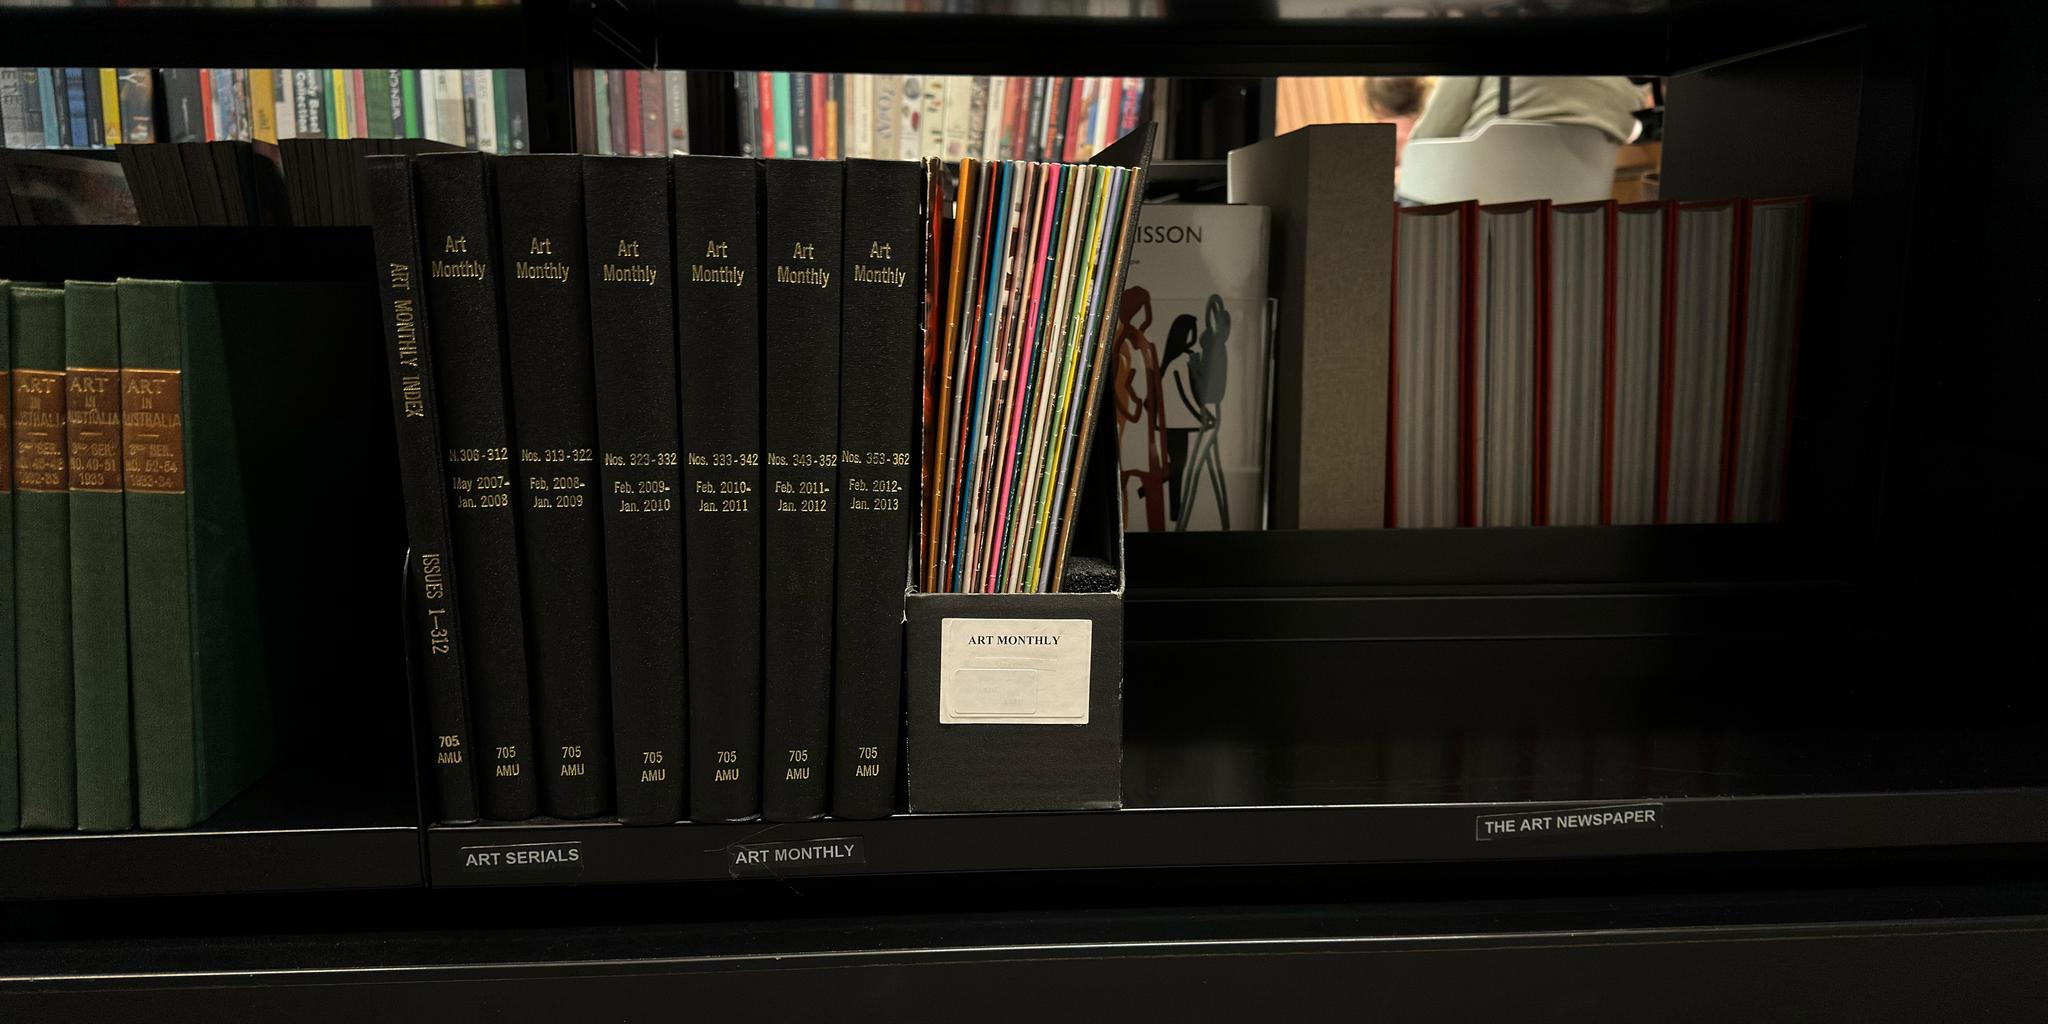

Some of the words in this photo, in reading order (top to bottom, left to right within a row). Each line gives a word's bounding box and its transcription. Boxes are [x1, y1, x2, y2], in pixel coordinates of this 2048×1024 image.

[296, 71, 308, 134] Collection
[445, 236, 467, 253] Art
[530, 238, 551, 255] Art
[618, 240, 639, 257] Art
[706, 241, 728, 258] Art
[793, 242, 814, 259] Art
[869, 241, 891, 259] Art
[390, 263, 410, 290] ART
[431, 261, 486, 280] Monthly
[516, 262, 570, 283] Monthly
[603, 264, 657, 285] Monthly
[692, 265, 744, 286] Monthly
[777, 265, 830, 288] Monthly
[855, 265, 906, 287] Monthly
[394, 300, 418, 367] MONTHLY
[18, 378, 57, 394] ART
[70, 377, 109, 394] ART
[127, 377, 166, 394] ART
[142, 395, 153, 410] IN
[402, 377, 424, 418] INDEX
[521, 449, 541, 462] Nos.
[605, 452, 626, 466] Nos.
[688, 453, 708, 466] Nos.
[767, 453, 788, 466] Nos.
[842, 451, 862, 464] Nos.
[453, 477, 473, 492] May
[614, 481, 634, 494] Feb.
[696, 481, 715, 494] Feb.
[775, 481, 794, 494] Feb.
[849, 478, 868, 491] Feb.
[458, 496, 476, 508] Jan.
[480, 494, 508, 508] 2008
[533, 496, 552, 508] Jan.
[556, 495, 583, 507] 2009
[619, 500, 639, 512] Jan.
[643, 499, 670, 511] 2010
[698, 500, 717, 512] Jan.
[722, 500, 748, 512] 2011
[777, 500, 797, 512] Jan.
[800, 500, 827, 512] 2012
[849, 497, 869, 510] Jan.
[873, 498, 899, 510] 2013
[422, 553, 443, 600] ISSUES
[968, 635, 993, 645] ART
[997, 635, 1060, 645] MONTHLY
[439, 735, 459, 748] 705
[437, 751, 462, 764] AMU
[496, 746, 515, 759] 705
[561, 746, 581, 758] 705
[643, 751, 663, 764] 705
[718, 751, 737, 763] 705
[789, 749, 808, 762] 705
[859, 747, 877, 759] 705
[496, 763, 520, 777] AMU
[560, 763, 584, 776] AMU
[641, 768, 666, 782] AMU
[715, 768, 739, 781] AMU
[786, 767, 809, 780] AMU
[856, 765, 880, 776] AMU
[1485, 821, 1516, 834] THE
[1520, 817, 1552, 832] ART
[1557, 810, 1656, 829] NEWSPAPER
[465, 852, 501, 867] ART
[505, 848, 580, 865] SERIALS
[735, 849, 770, 865] ART
[774, 844, 855, 862] MONTHLY
